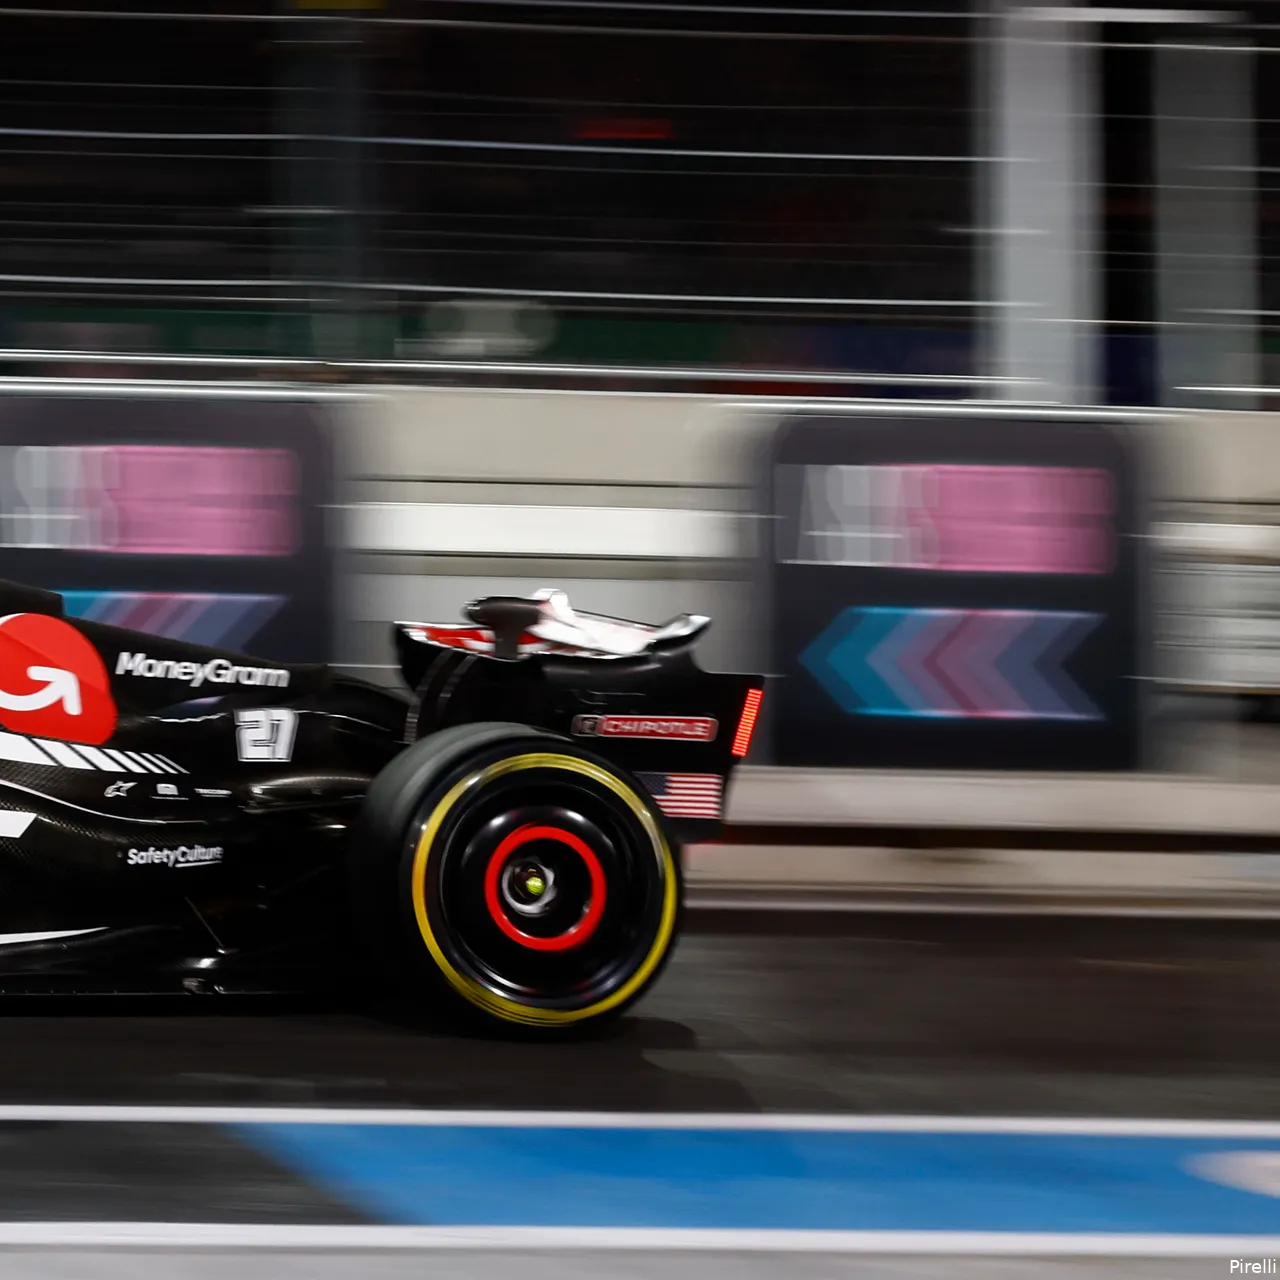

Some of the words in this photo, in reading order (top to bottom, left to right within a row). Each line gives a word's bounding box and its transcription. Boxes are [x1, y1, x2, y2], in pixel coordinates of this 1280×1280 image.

[115, 652, 290, 687] MoneyGram
[234, 708, 300, 762] 27
[603, 720, 711, 735] CHIPOTLE
[127, 845, 224, 867] SafetyCulture
